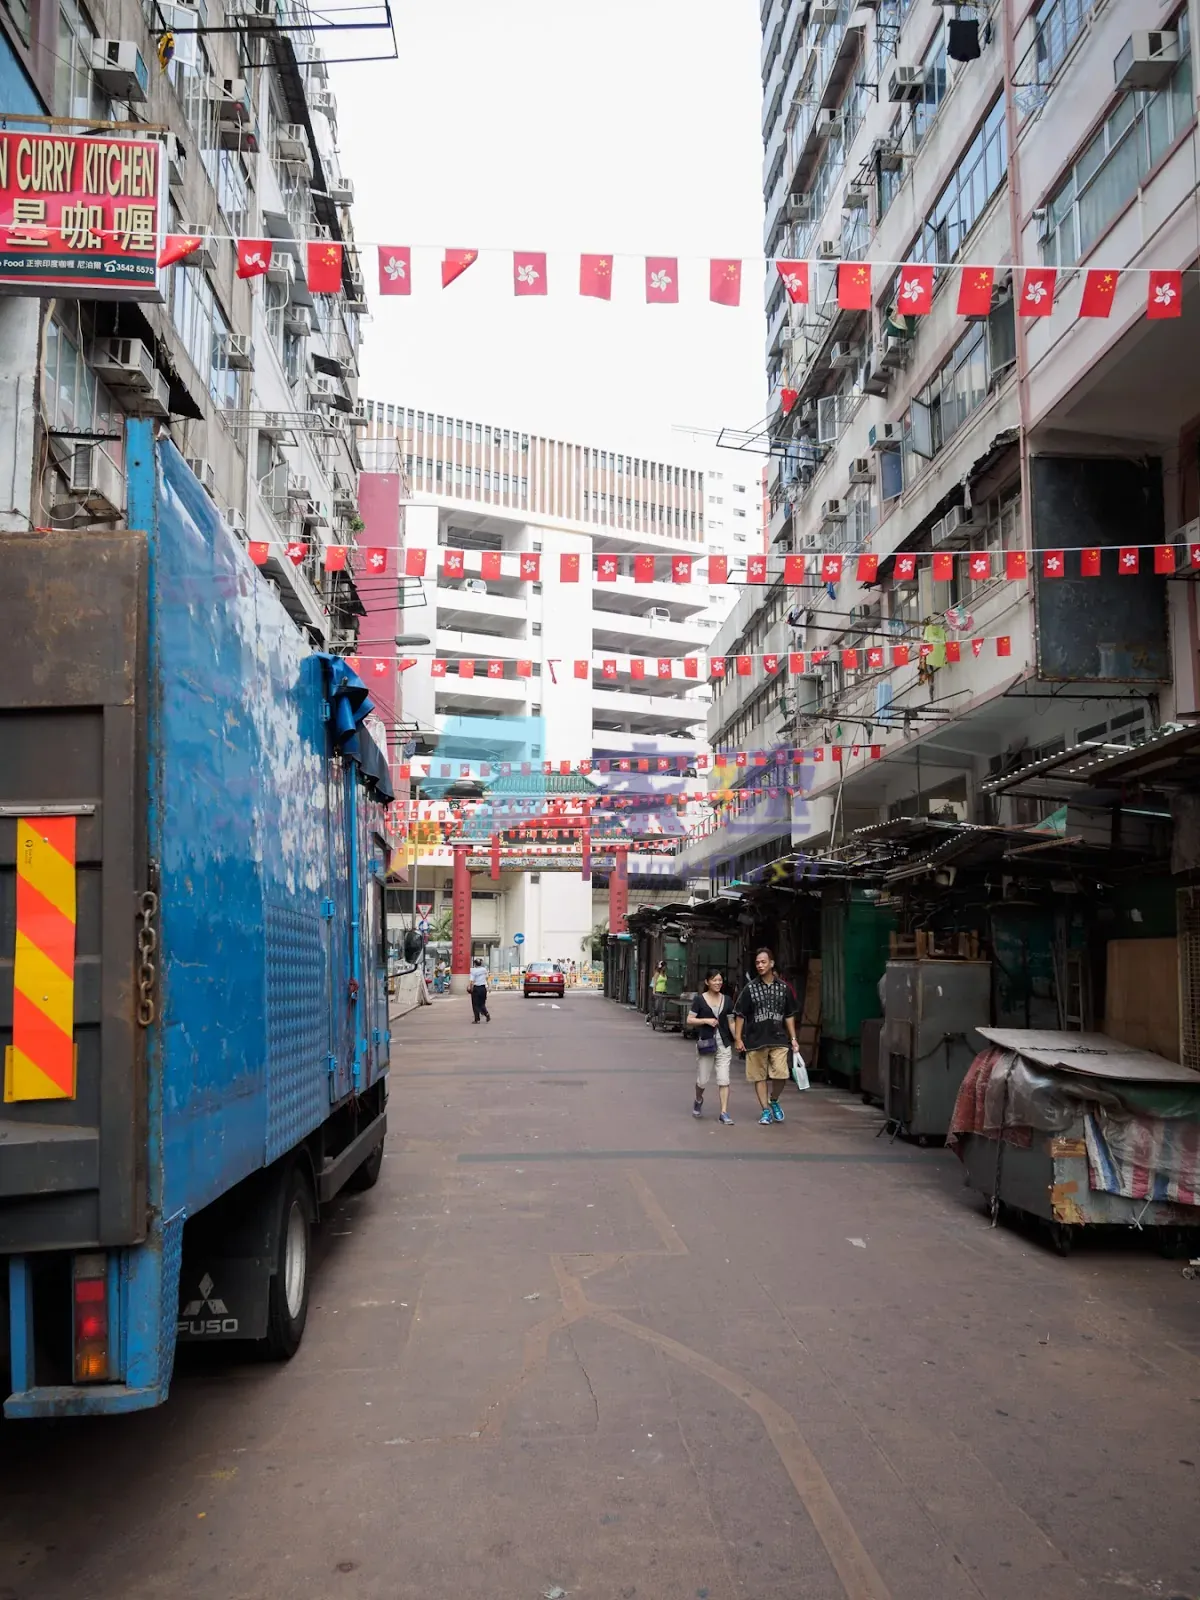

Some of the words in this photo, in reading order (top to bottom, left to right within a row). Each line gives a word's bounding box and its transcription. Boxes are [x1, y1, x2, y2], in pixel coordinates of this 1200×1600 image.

[16, 138, 76, 192] CURRY
[83, 143, 155, 197] KITCHEN
[4, 259, 25, 268] Food
[116, 264, 135, 272] 3542
[135, 265, 155, 275] 5575
[178, 1318, 239, 1335] FUSO
